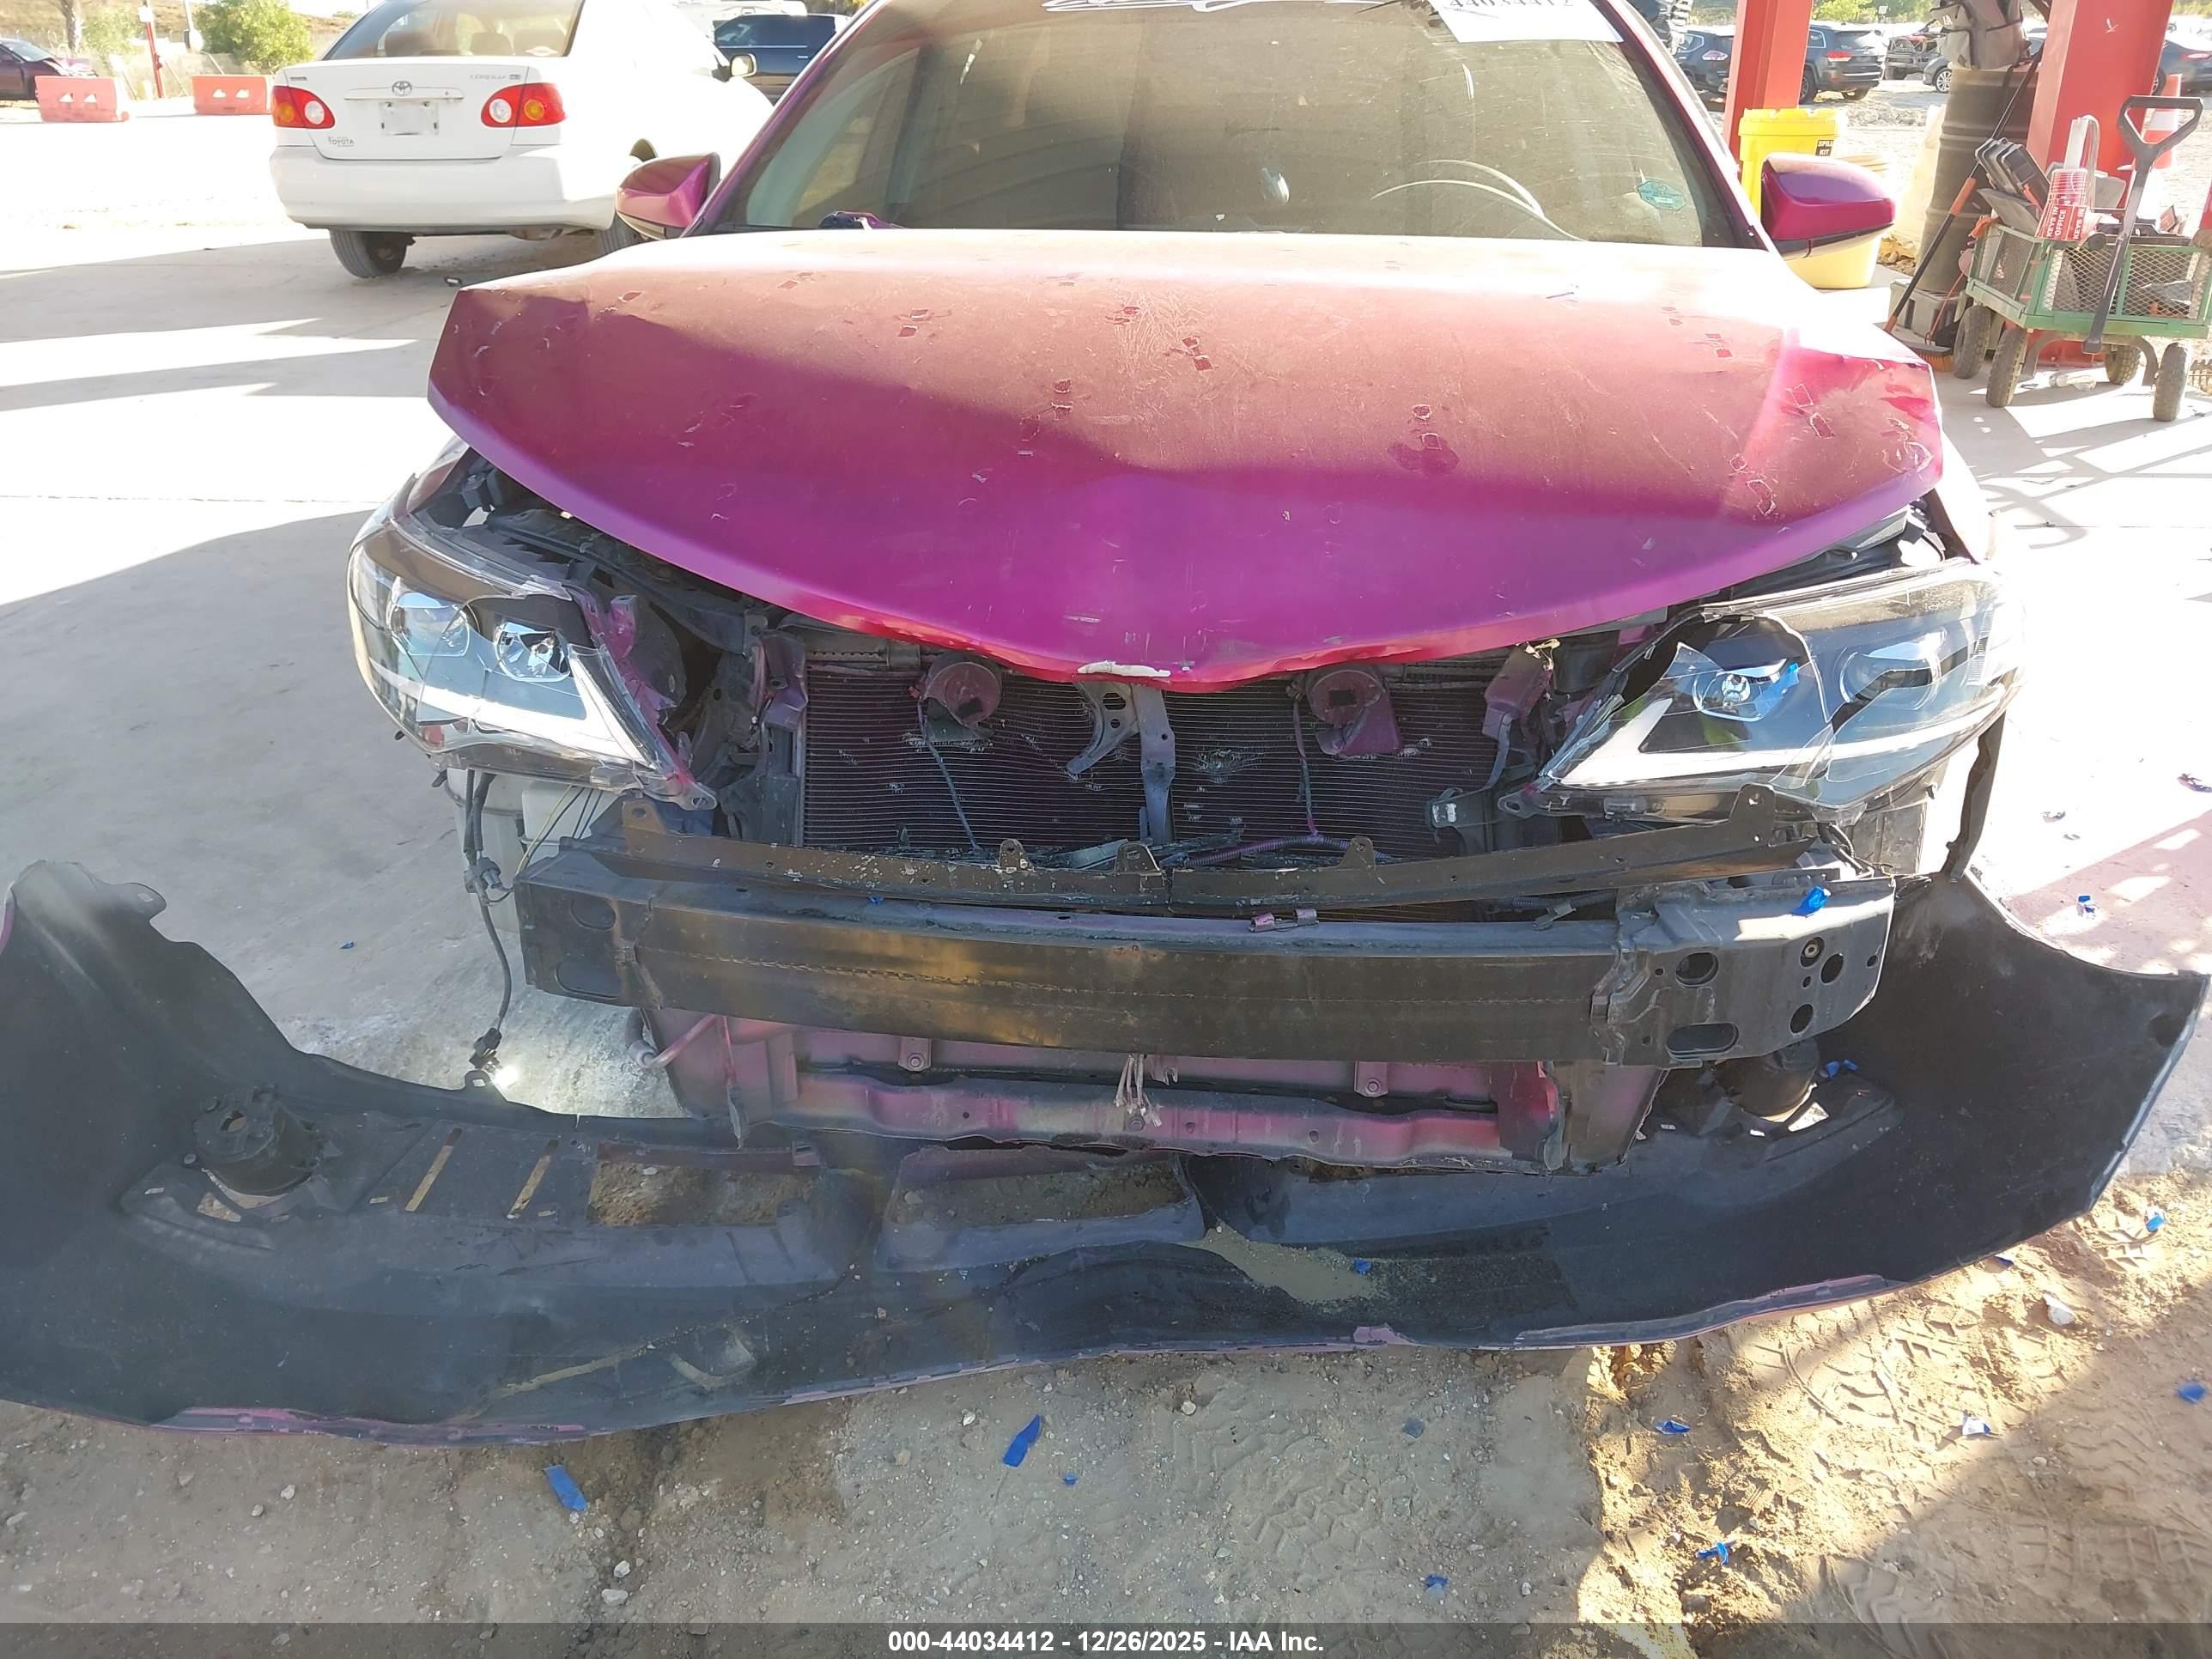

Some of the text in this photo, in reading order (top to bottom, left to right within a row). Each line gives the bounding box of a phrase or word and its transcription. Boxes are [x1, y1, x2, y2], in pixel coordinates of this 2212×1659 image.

[327, 136, 355, 145] TOYOTA
[2046, 206, 2059, 237] KEYS IN
[2055, 209, 2067, 235] OFFICE
[2073, 208, 2086, 240] KEYS IN
